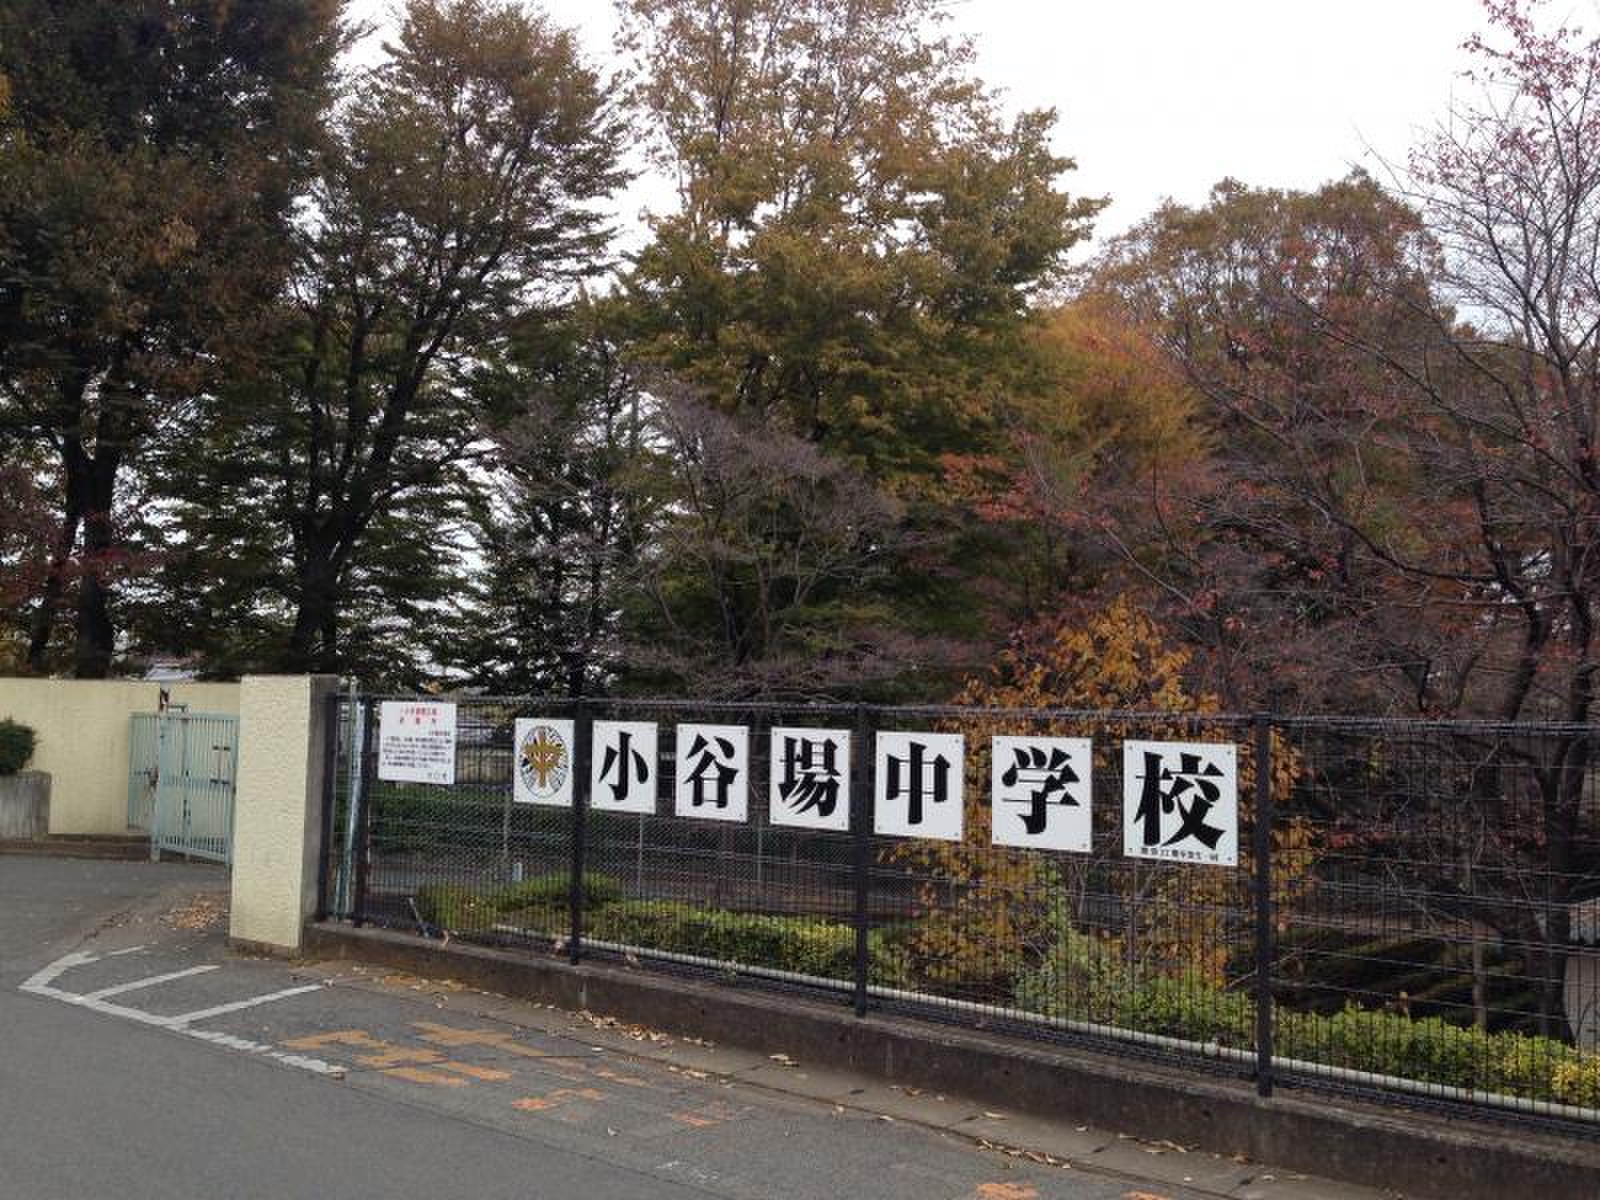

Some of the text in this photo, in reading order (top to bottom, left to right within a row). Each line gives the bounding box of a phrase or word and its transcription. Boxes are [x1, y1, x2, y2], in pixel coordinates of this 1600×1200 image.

[599, 731, 1226, 849] 小谷場中学校
